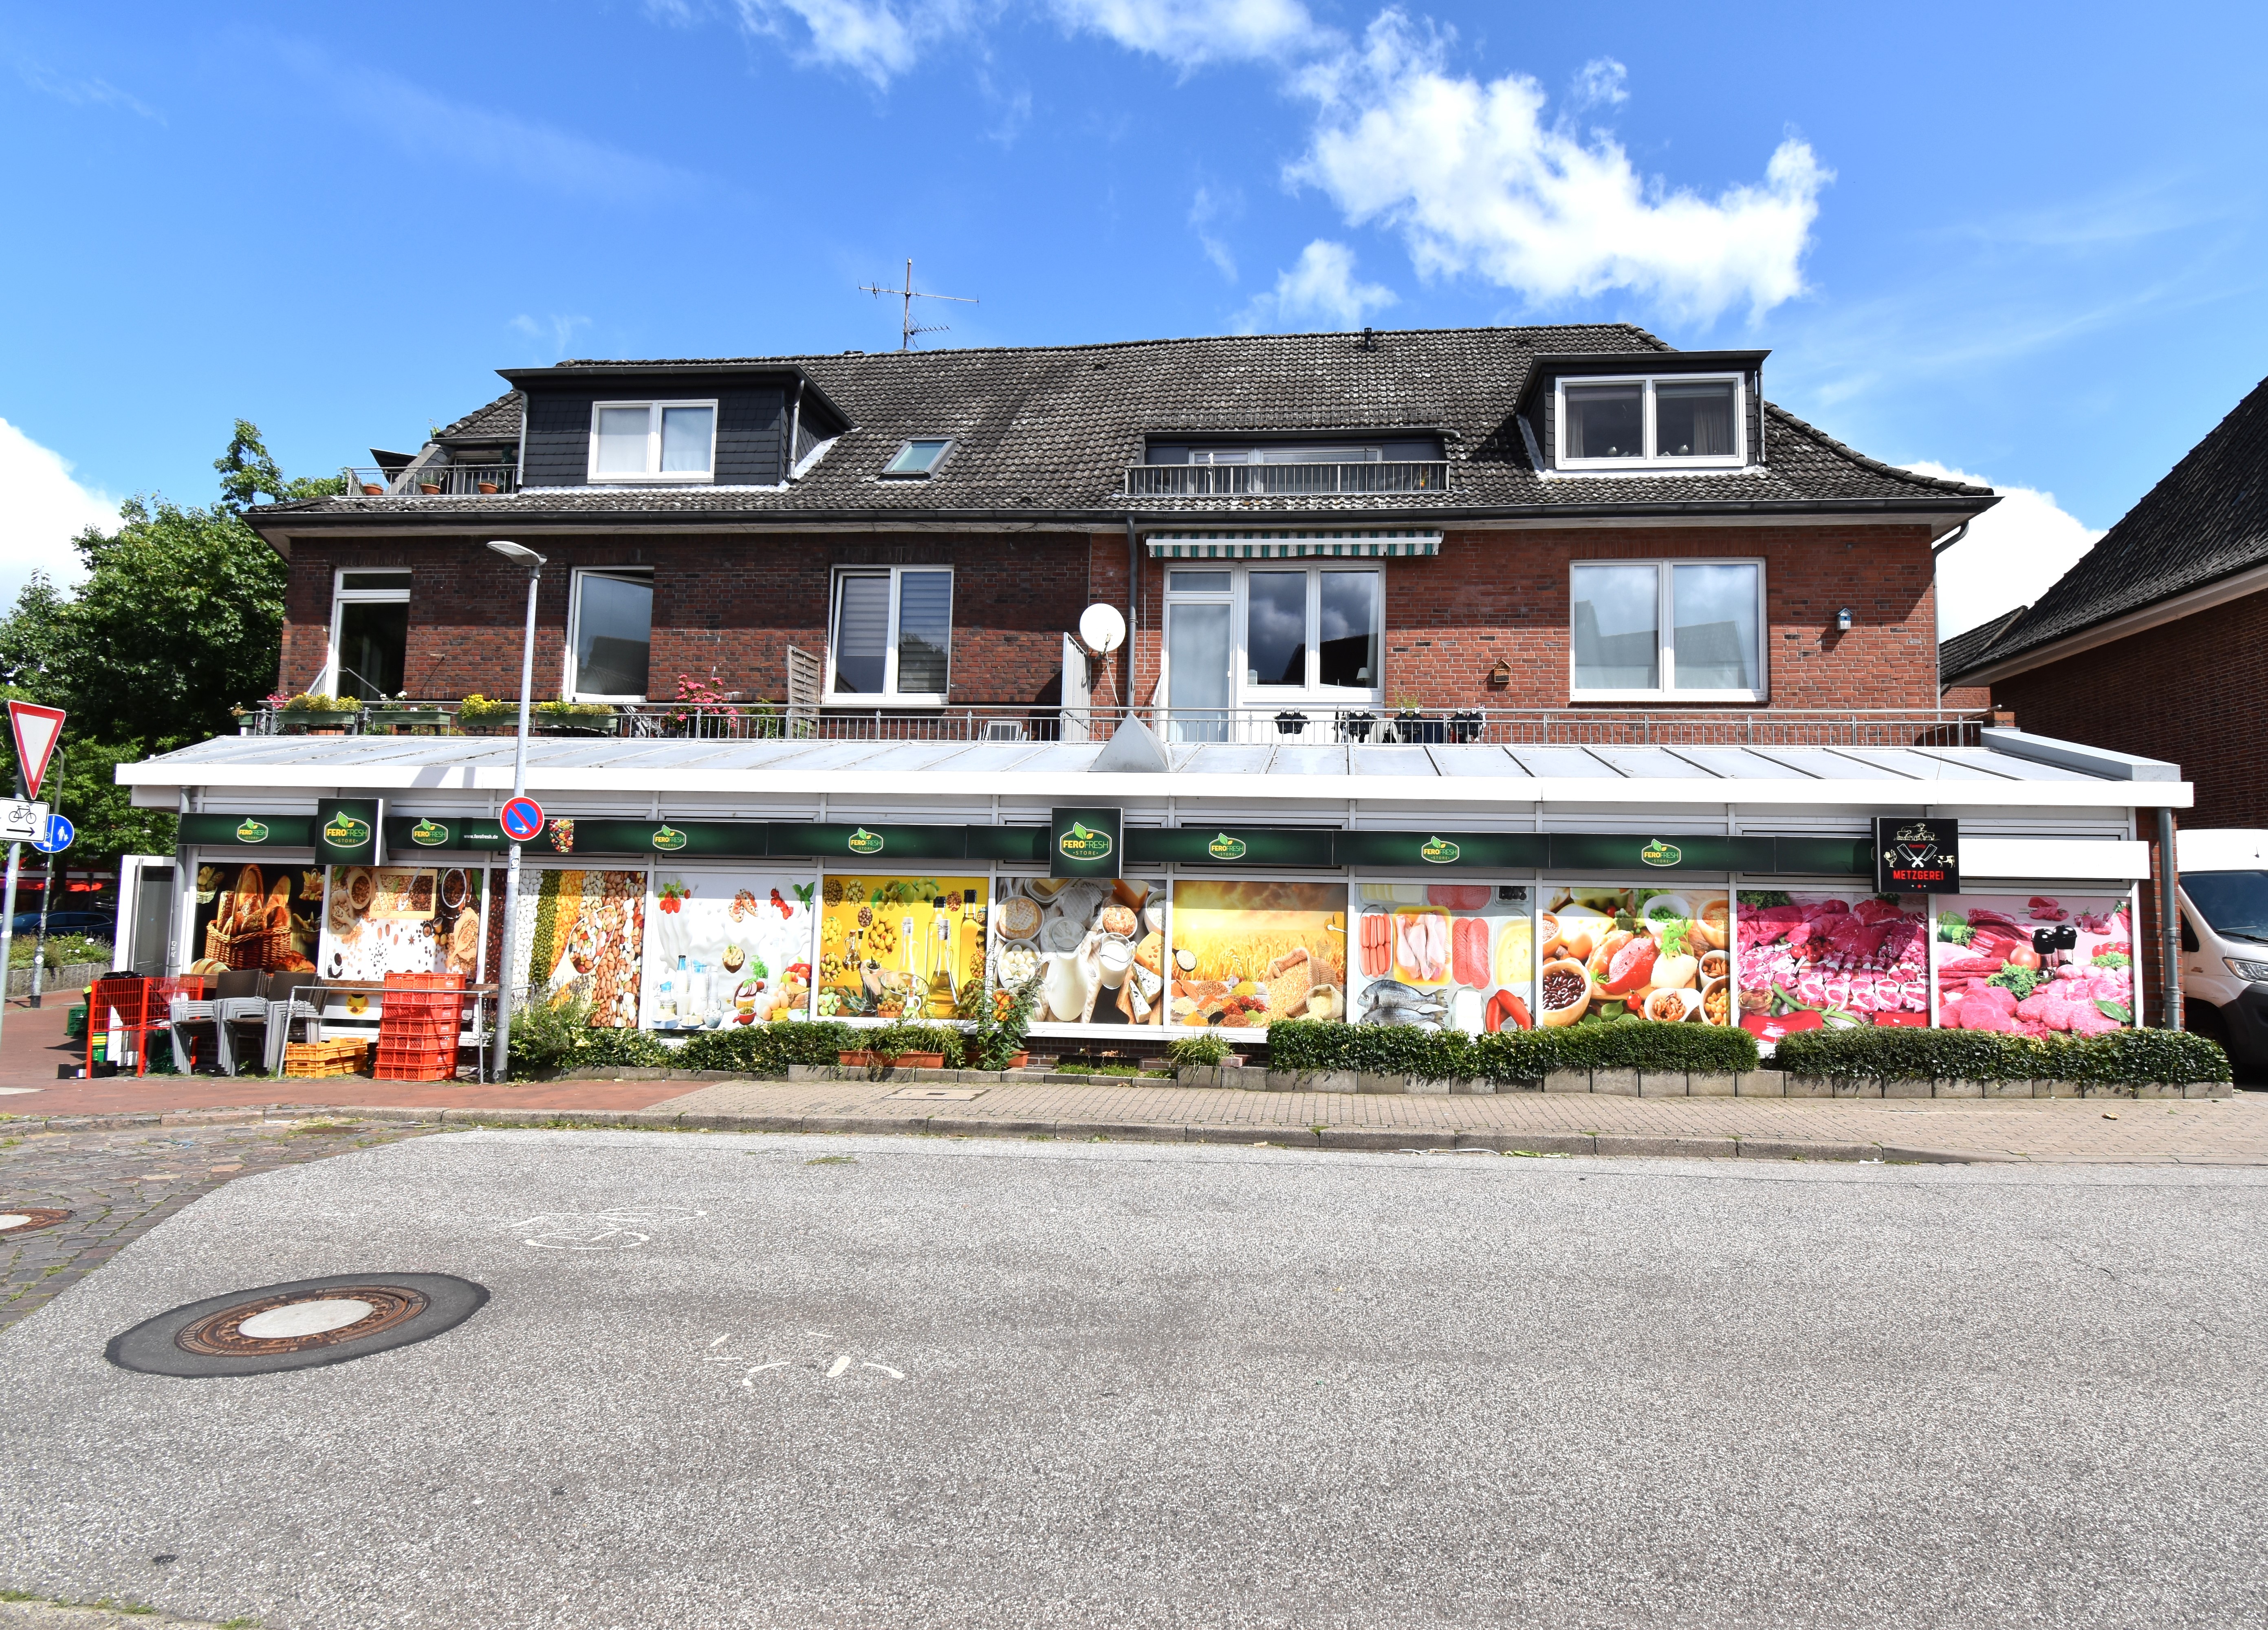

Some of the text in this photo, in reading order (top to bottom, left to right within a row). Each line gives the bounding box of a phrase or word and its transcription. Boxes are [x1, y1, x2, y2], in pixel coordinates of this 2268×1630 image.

[327, 828, 367, 837] FEROFRESH
[1064, 840, 1108, 848] FEROFRESH
[1893, 870, 1944, 880] METZGEREI
